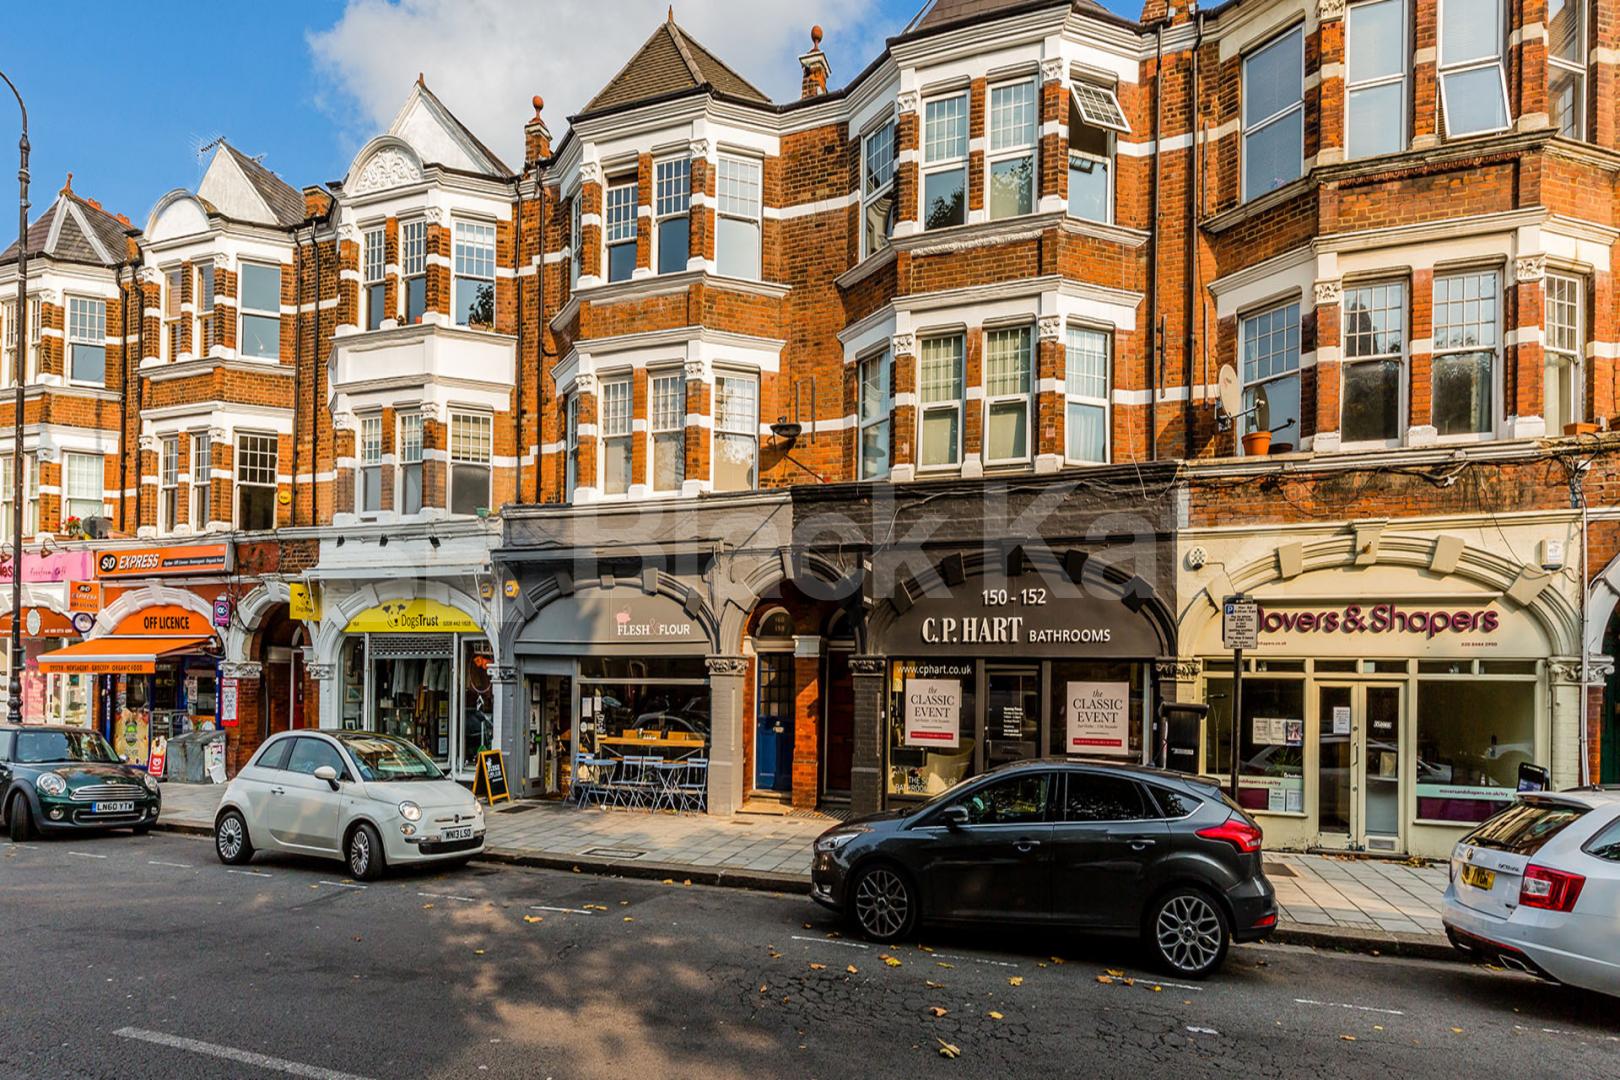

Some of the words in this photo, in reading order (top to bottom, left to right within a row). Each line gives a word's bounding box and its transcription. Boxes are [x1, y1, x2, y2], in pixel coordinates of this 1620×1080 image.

[119, 554, 160, 569] EXPRESS
[981, 589, 1007, 605] 150
[1020, 588, 1047, 604] 152
[143, 616, 157, 629] OFF
[159, 616, 190, 629] LICENCE
[1257, 607, 1340, 633] overs
[617, 624, 650, 636] FLESH
[659, 624, 690, 635] FLOUR
[962, 616, 1023, 643] HART
[1029, 629, 1111, 642] BATHROOMS
[897, 664, 972, 677] www.cphart.co.uk
[928, 686, 938, 694] the
[1093, 689, 1103, 698] the
[911, 694, 955, 705] CLASSIC
[1073, 698, 1123, 710] CLASSIC
[915, 707, 951, 718] EVENT
[1078, 711, 1119, 723] EVENT
